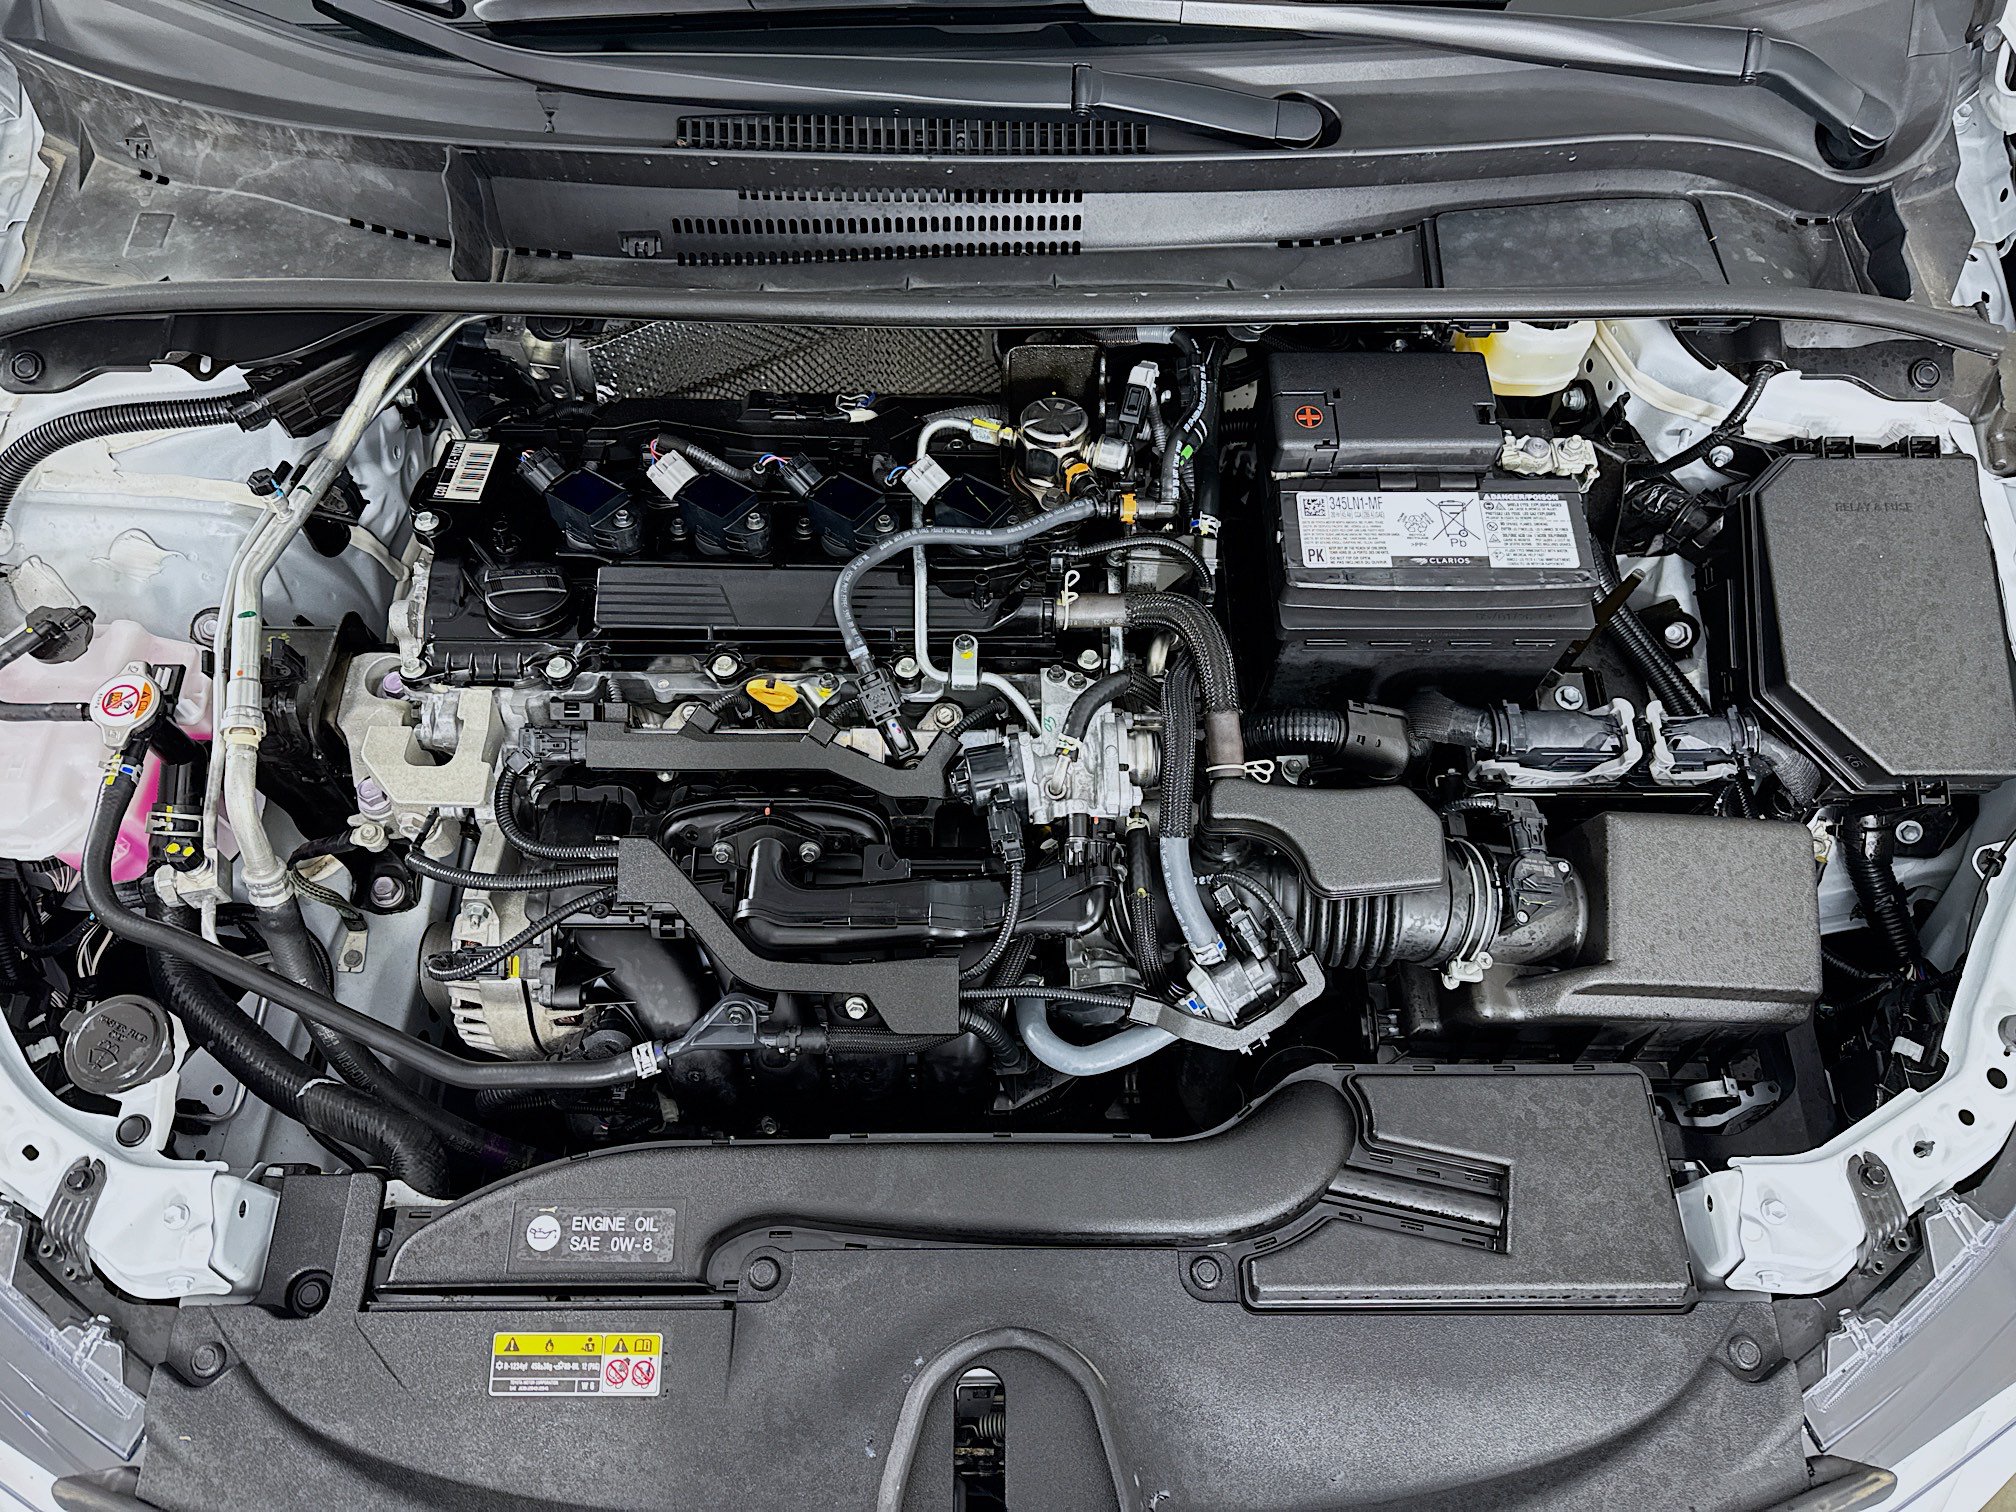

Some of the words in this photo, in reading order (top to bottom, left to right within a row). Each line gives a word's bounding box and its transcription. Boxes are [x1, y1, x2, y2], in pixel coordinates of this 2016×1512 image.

[1329, 496, 1383, 510] 345LN1-MF
[1835, 502, 1870, 512] RELAY
[1885, 501, 1913, 512] FUSE
[1450, 538, 1467, 547] Pb
[1308, 548, 1325, 562] PK
[571, 1216, 626, 1232] ENGINE
[634, 1216, 659, 1232] OIL
[569, 1236, 600, 1251] SAE
[610, 1237, 653, 1252] 0W-8
